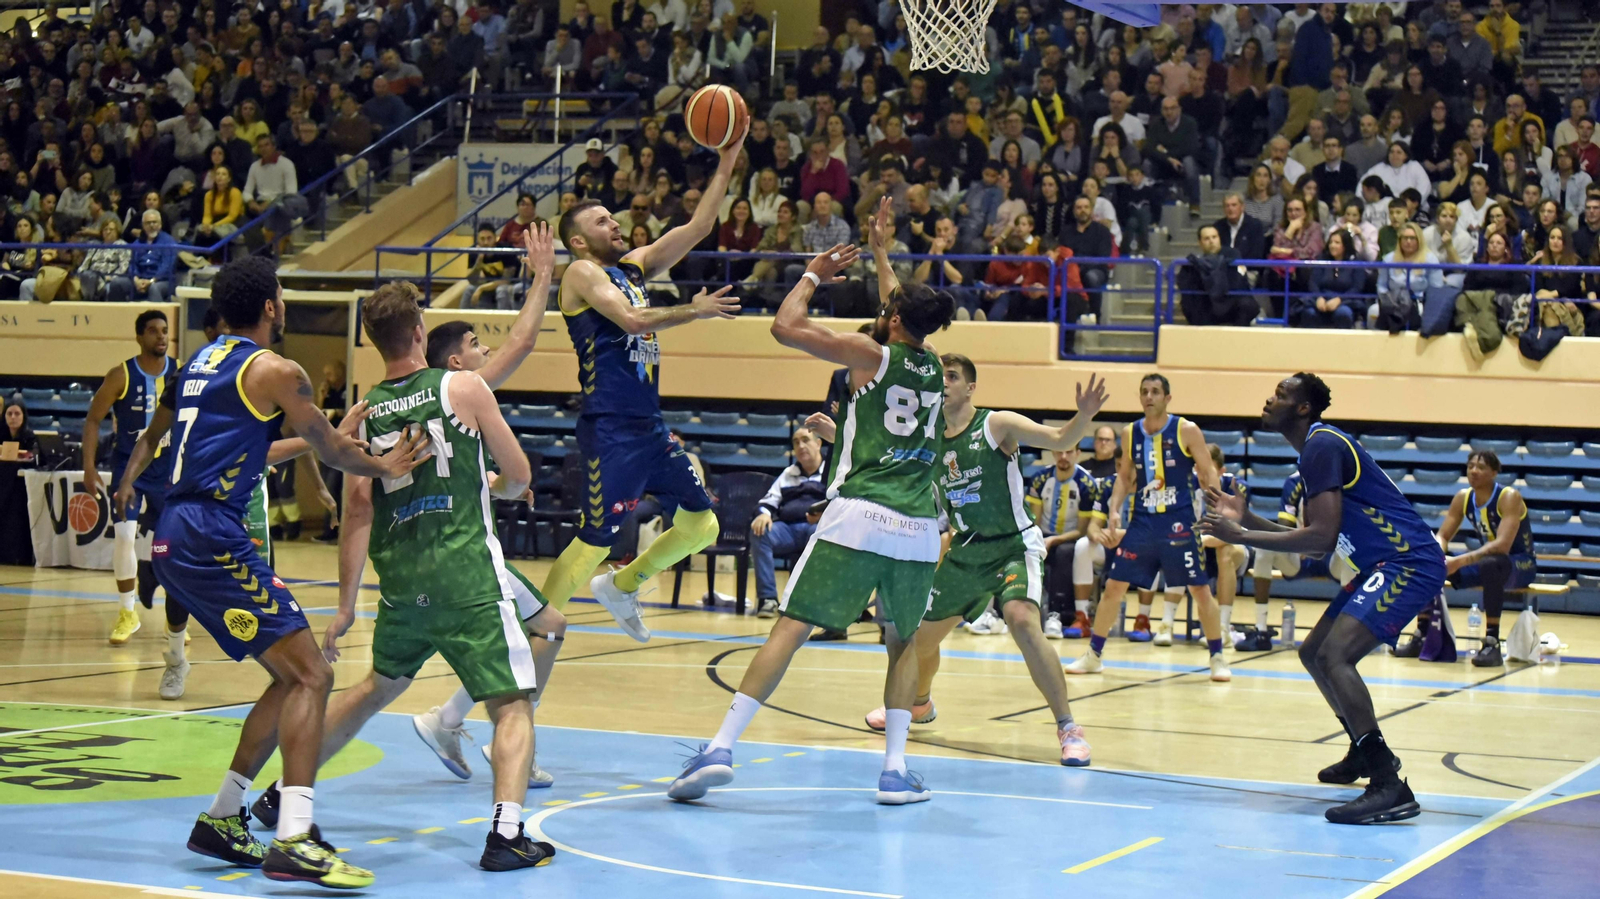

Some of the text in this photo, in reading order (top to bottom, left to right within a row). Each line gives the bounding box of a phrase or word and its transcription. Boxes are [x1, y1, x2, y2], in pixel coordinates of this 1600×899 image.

[71, 315, 93, 326] TV
[369, 388, 436, 420] MCDONNELL
[884, 384, 942, 440] 87
[172, 407, 199, 485] 7
[1184, 551, 1194, 568] 5
[1363, 571, 1385, 593] 0
